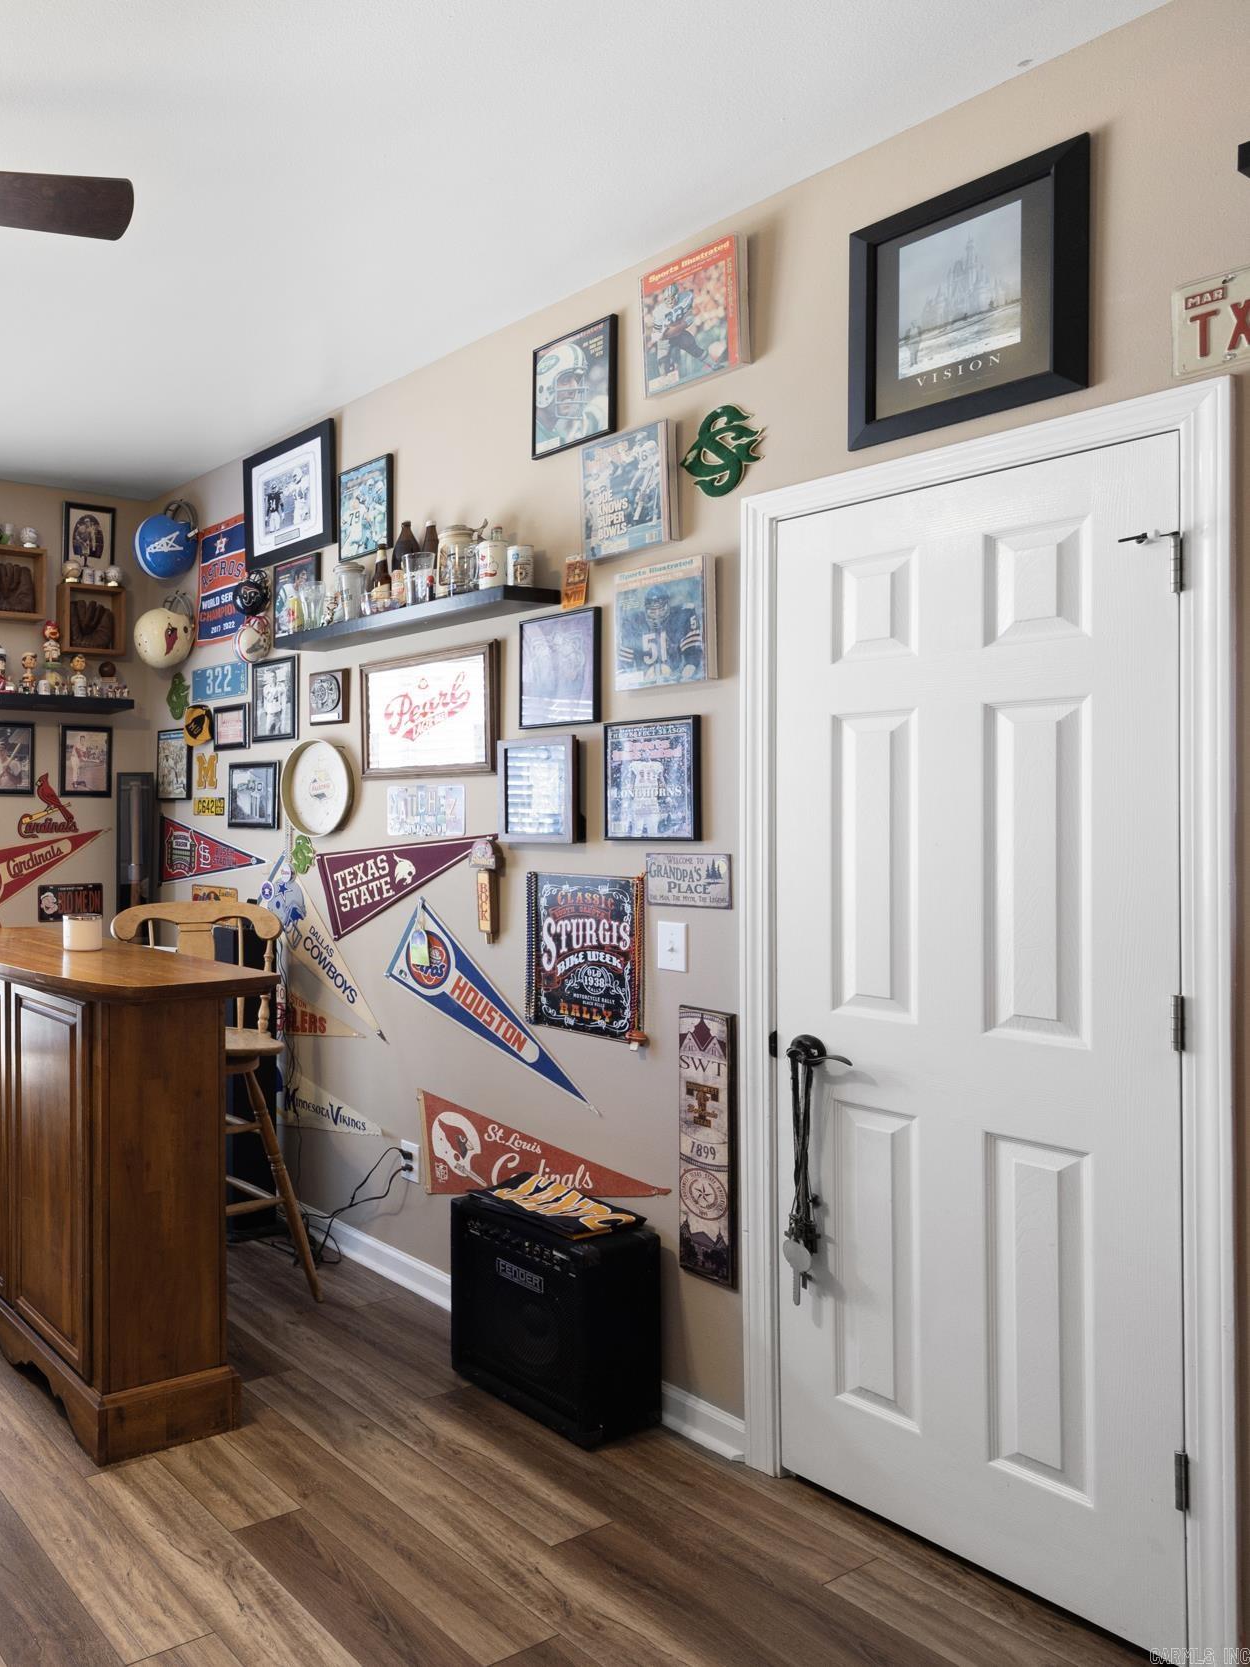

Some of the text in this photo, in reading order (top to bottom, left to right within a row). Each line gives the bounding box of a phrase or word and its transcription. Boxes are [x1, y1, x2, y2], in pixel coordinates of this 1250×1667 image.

[649, 265, 679, 283] Sports
[681, 240, 730, 268] Illustrated
[1187, 288, 1224, 308] MAR
[917, 352, 1002, 388] VISION
[350, 511, 360, 527] 79
[598, 497, 629, 515] KNOWS
[598, 511, 625, 528] SUPER
[598, 522, 628, 540] BOWLS
[201, 560, 245, 588] ASTROS
[649, 559, 694, 574] Illustrated
[202, 595, 220, 609] WORLD
[642, 631, 668, 665] 51
[206, 664, 232, 695] 322
[658, 727, 687, 735] SEASON
[196, 752, 218, 790] M
[18, 813, 79, 839] Cardinals
[7, 846, 64, 879] Cardinals
[333, 854, 390, 892] TEXAS
[650, 862, 702, 882] GRANDPA'S
[667, 856, 693, 864] WELCOME
[339, 877, 395, 913] STATE
[556, 890, 615, 909] CLASSIC
[667, 881, 710, 894] PLACE
[478, 883, 488, 921] BOCK
[309, 925, 335, 957] DALLAS
[541, 916, 631, 971] STURGIS
[303, 936, 358, 1005] COWBOYS
[556, 950, 624, 976] BIKE WEEK
[586, 968, 601, 978] OLD
[584, 977, 605, 989] 1938
[450, 975, 529, 1053] HOUSTON
[559, 1002, 614, 1023] RALLY
[679, 1054, 727, 1077] SWT
[484, 1124, 542, 1155] St. Louis
[690, 1141, 717, 1161] 1899
[499, 1258, 543, 1290] FENDER
